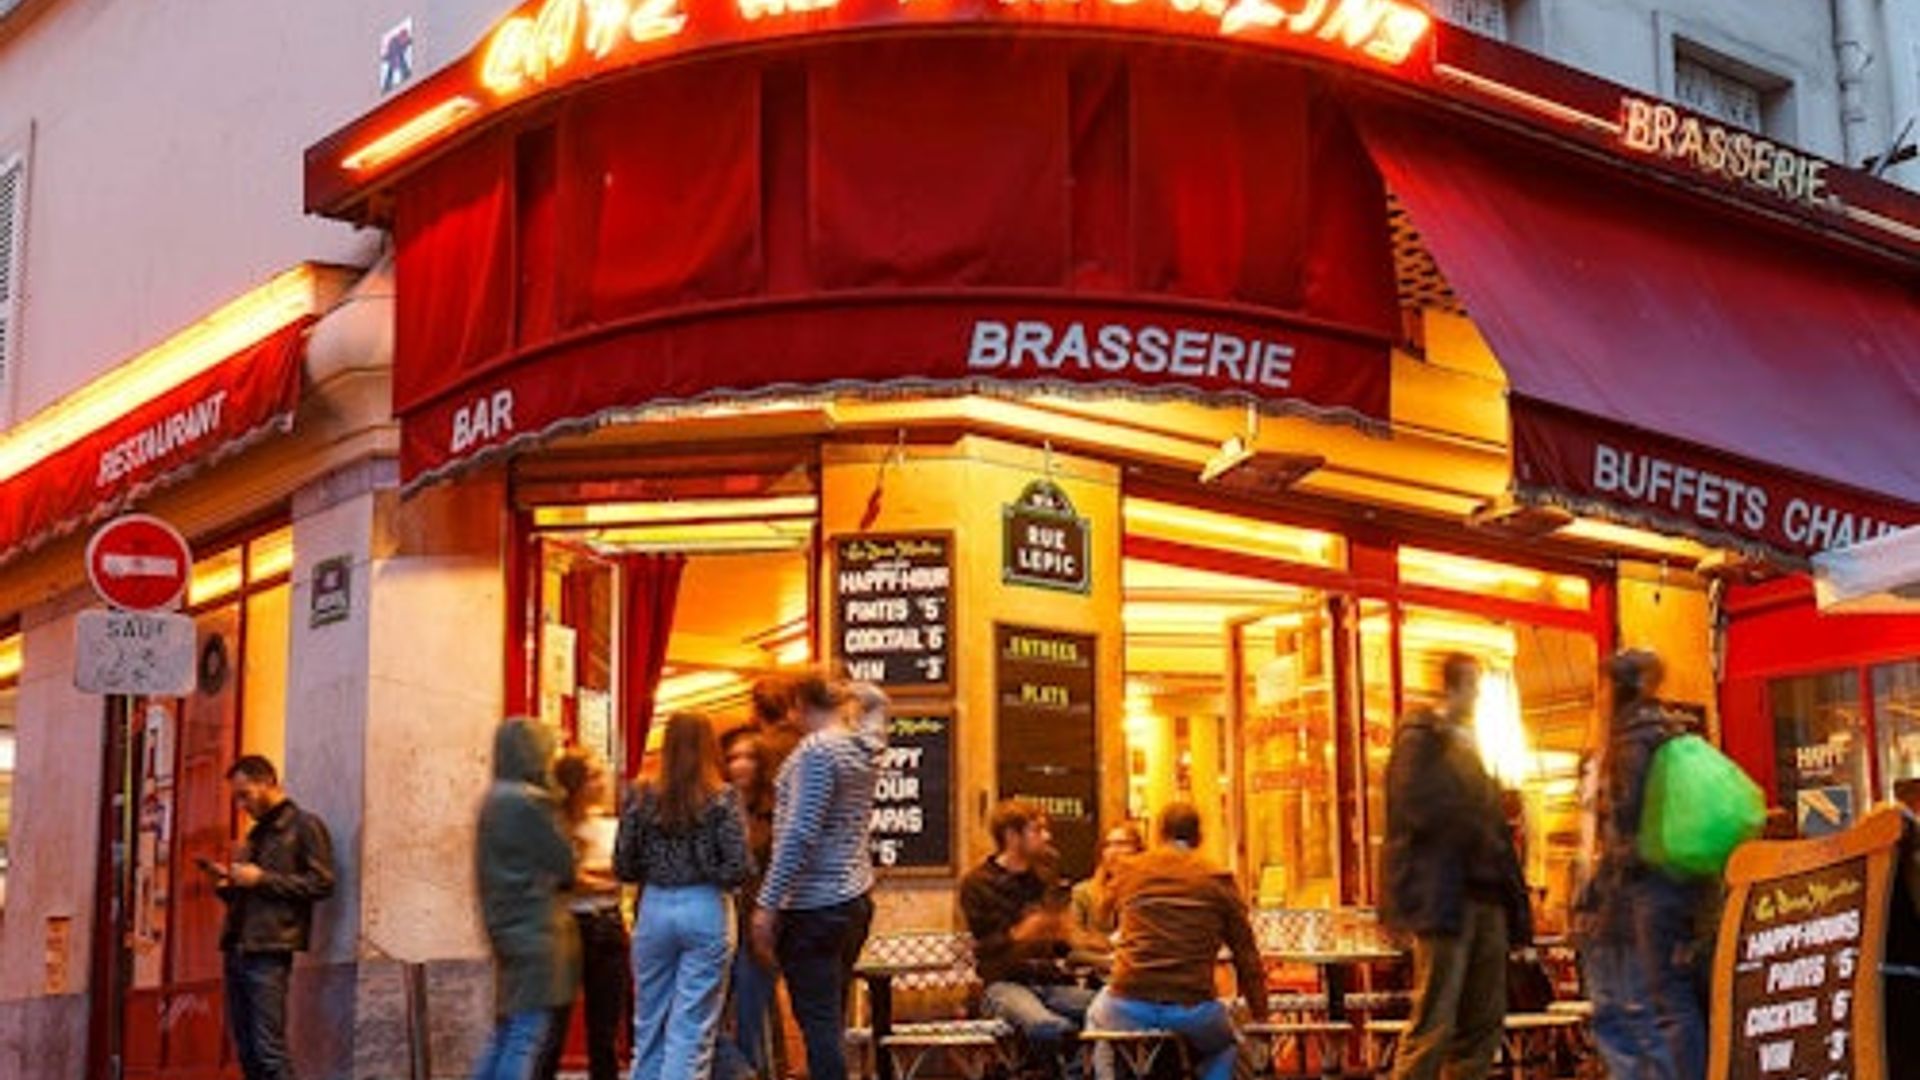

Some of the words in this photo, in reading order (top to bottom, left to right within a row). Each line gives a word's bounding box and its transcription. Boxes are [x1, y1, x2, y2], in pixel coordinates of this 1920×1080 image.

[1621, 97, 1829, 205] BRASSERIE
[967, 320, 1295, 388] BRASSERIE
[96, 390, 227, 487] RESTAURANT
[449, 389, 513, 453] BAR
[1594, 444, 1768, 531] BUFFETS
[1027, 526, 1066, 551] RUE
[1018, 548, 1076, 575] LEPIC
[847, 660, 885, 681] VIN
[874, 776, 920, 801] OUR
[869, 807, 923, 833] APAS
